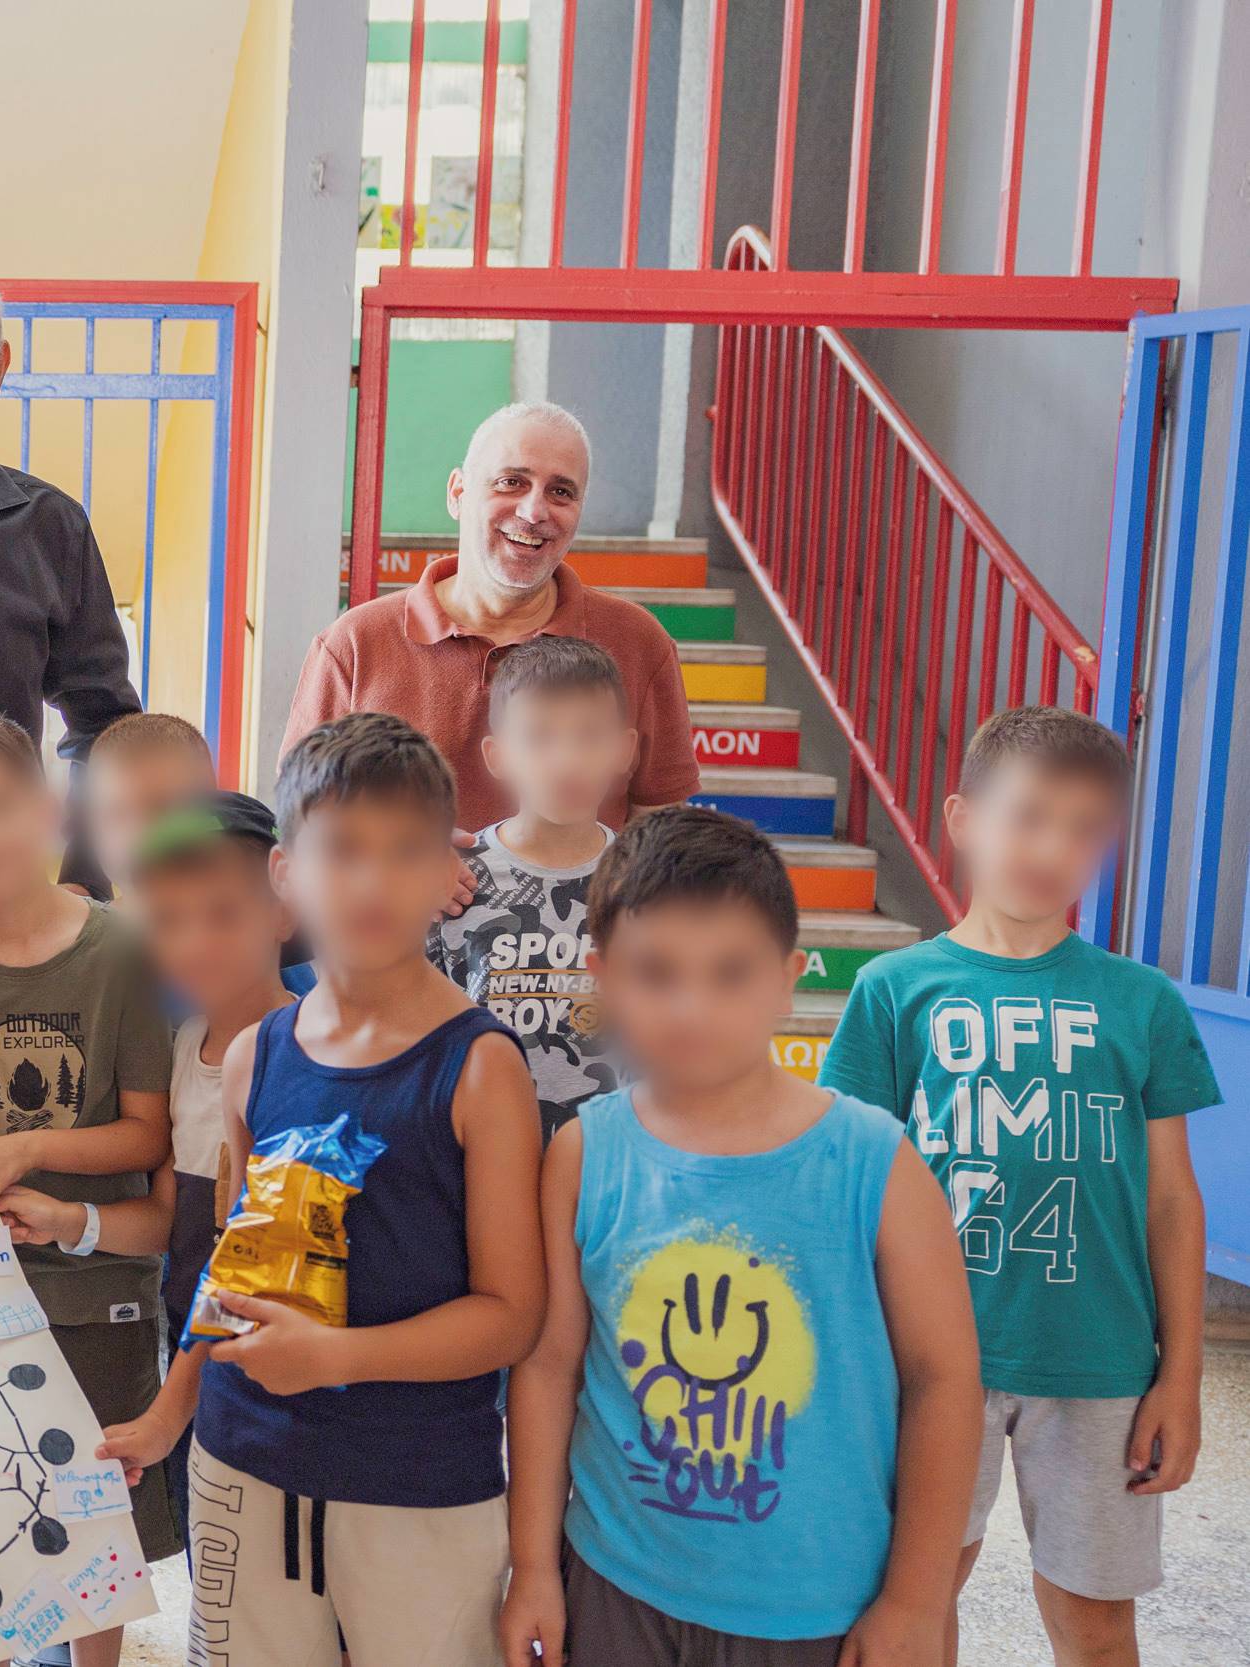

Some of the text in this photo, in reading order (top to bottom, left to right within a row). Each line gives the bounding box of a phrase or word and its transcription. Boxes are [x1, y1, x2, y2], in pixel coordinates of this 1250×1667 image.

[4, 1034, 86, 1049] EXPLORER
[6, 1012, 81, 1033] OUTDOOR
[930, 997, 1099, 1073] OFF
[914, 1076, 1124, 1162] LIMIT
[950, 1160, 1076, 1282] 64
